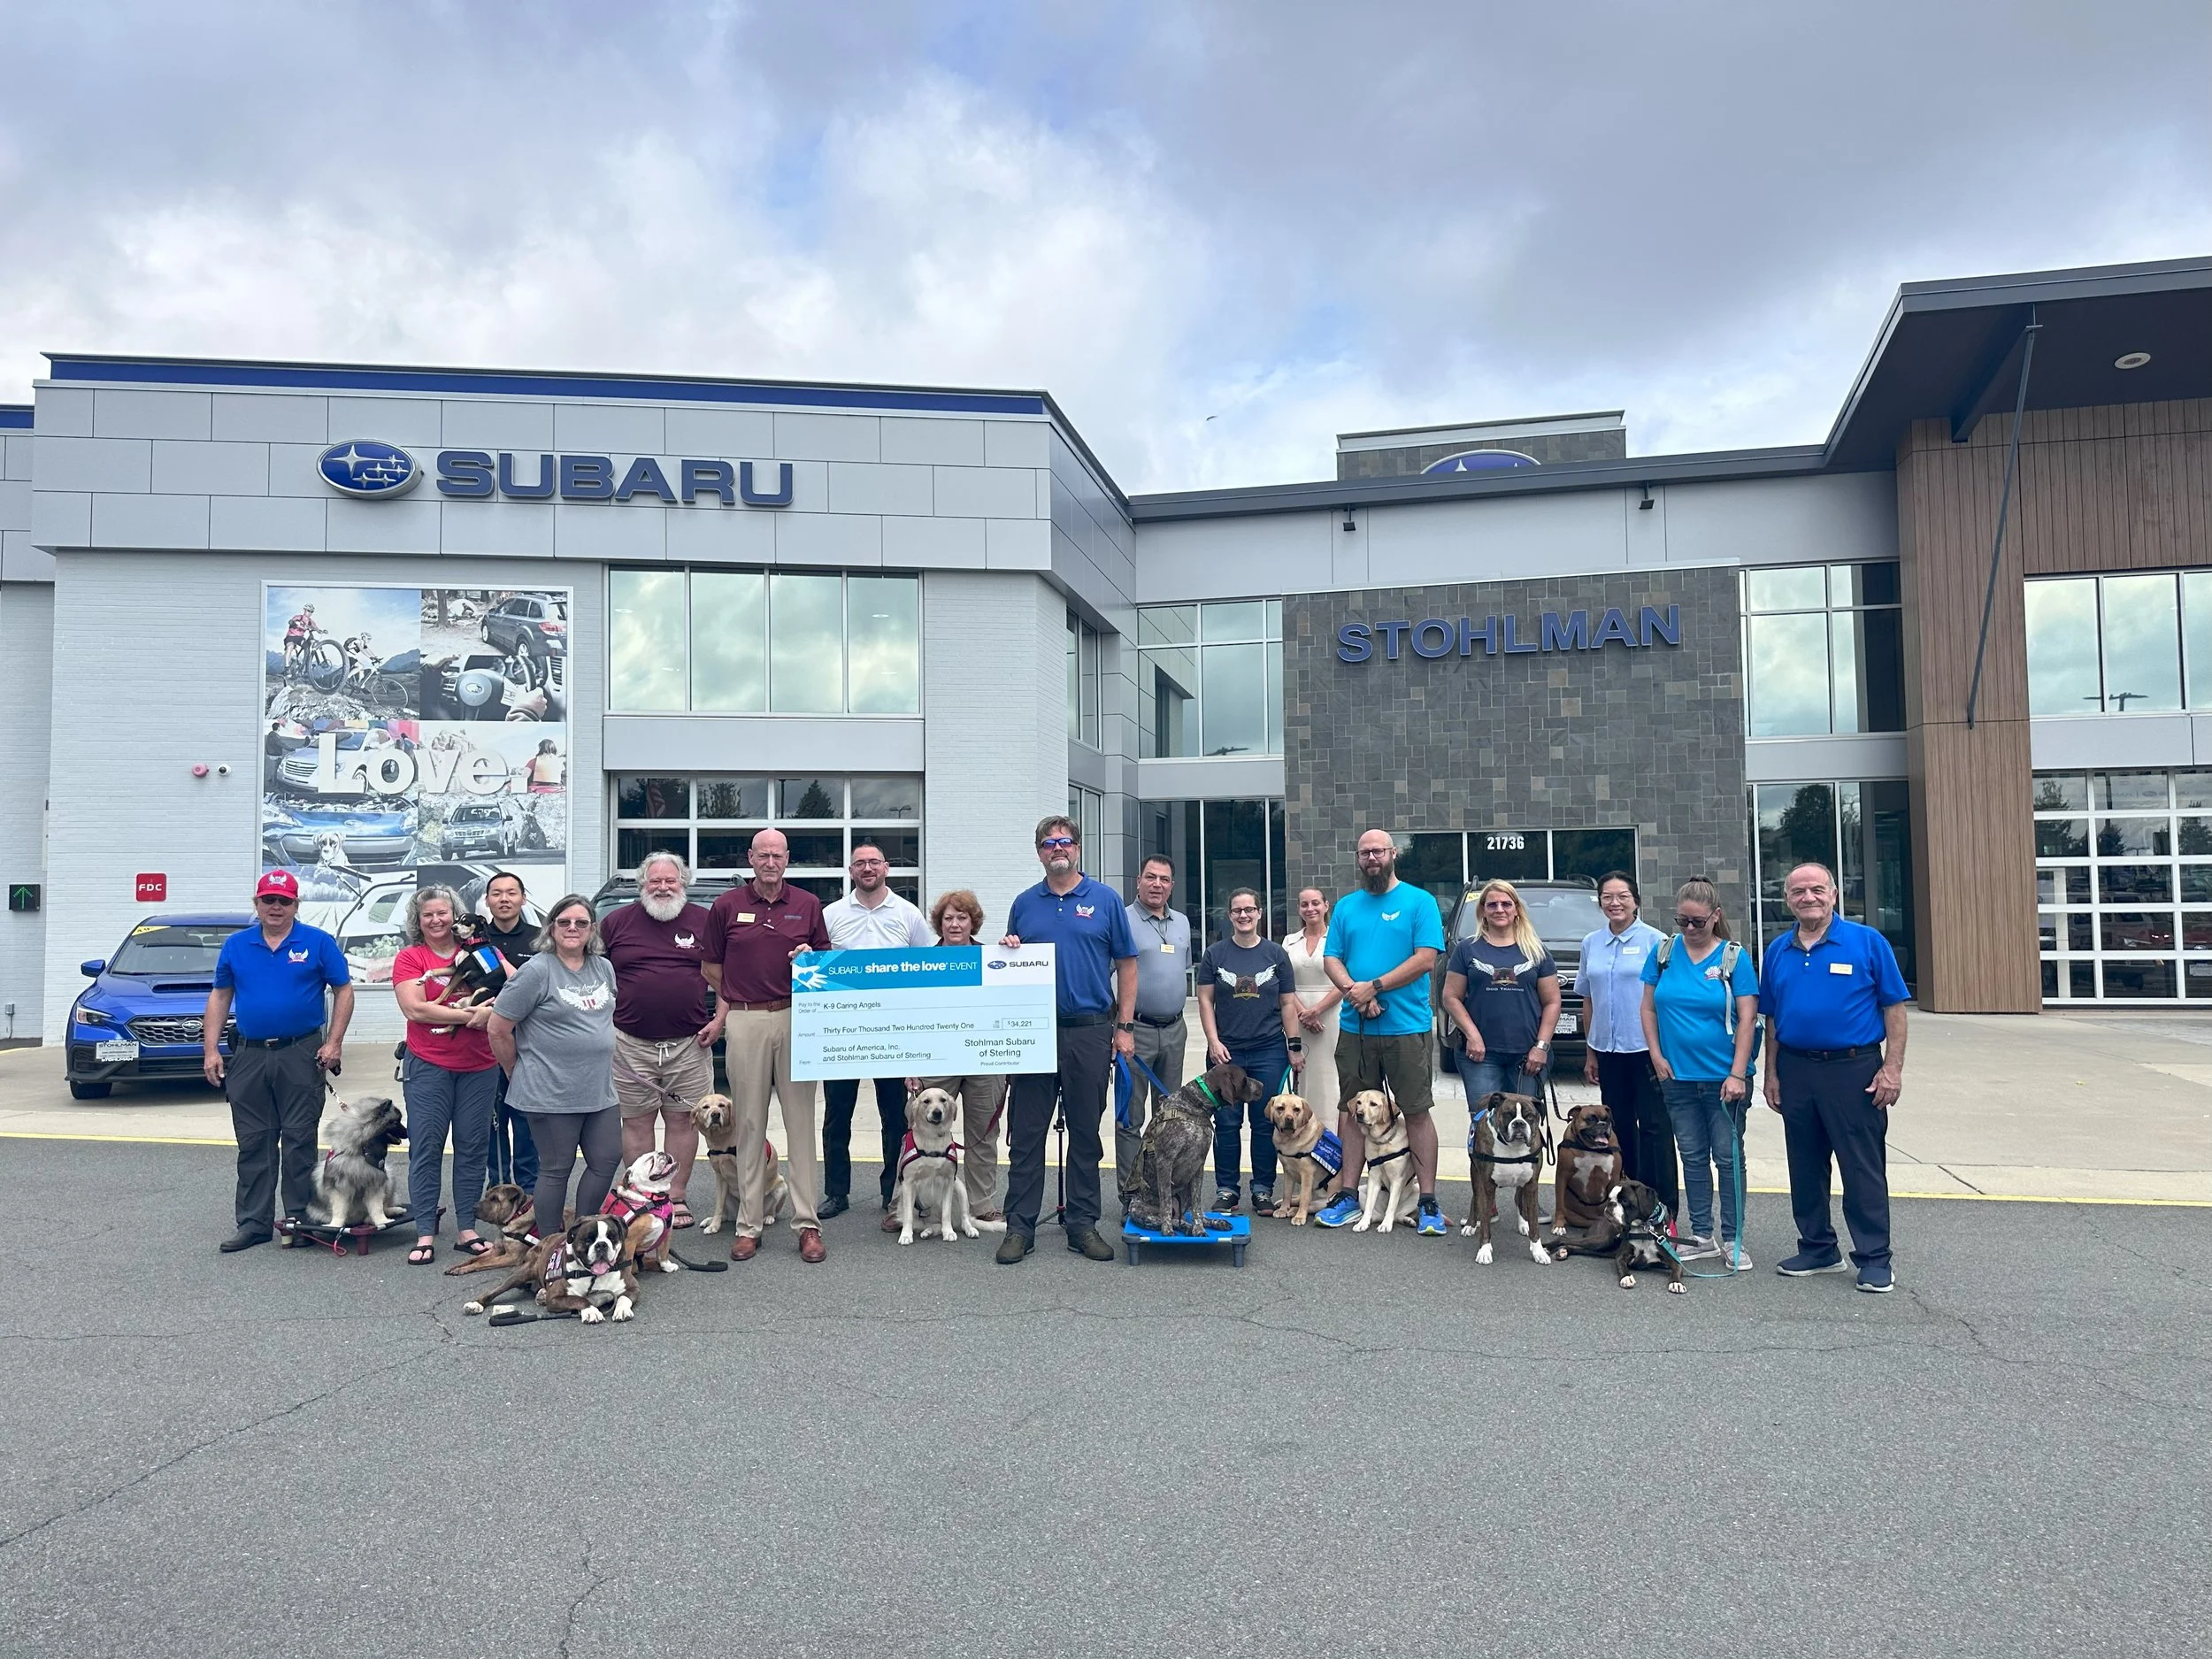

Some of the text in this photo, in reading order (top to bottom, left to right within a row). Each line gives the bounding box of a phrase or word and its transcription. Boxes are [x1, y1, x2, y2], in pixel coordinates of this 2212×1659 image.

[436, 450, 794, 505] SUBARU
[1336, 604, 1681, 662] STOHLMAN
[318, 733, 528, 795] Love.
[1487, 836, 1525, 850] 21736
[828, 966, 863, 975] SUBARU
[865, 962, 899, 973] share
[901, 962, 922, 972] the
[950, 962, 977, 970] EVENT
[965, 1039, 1004, 1047] Stohlman
[990, 1049, 1021, 1058] Sterling
